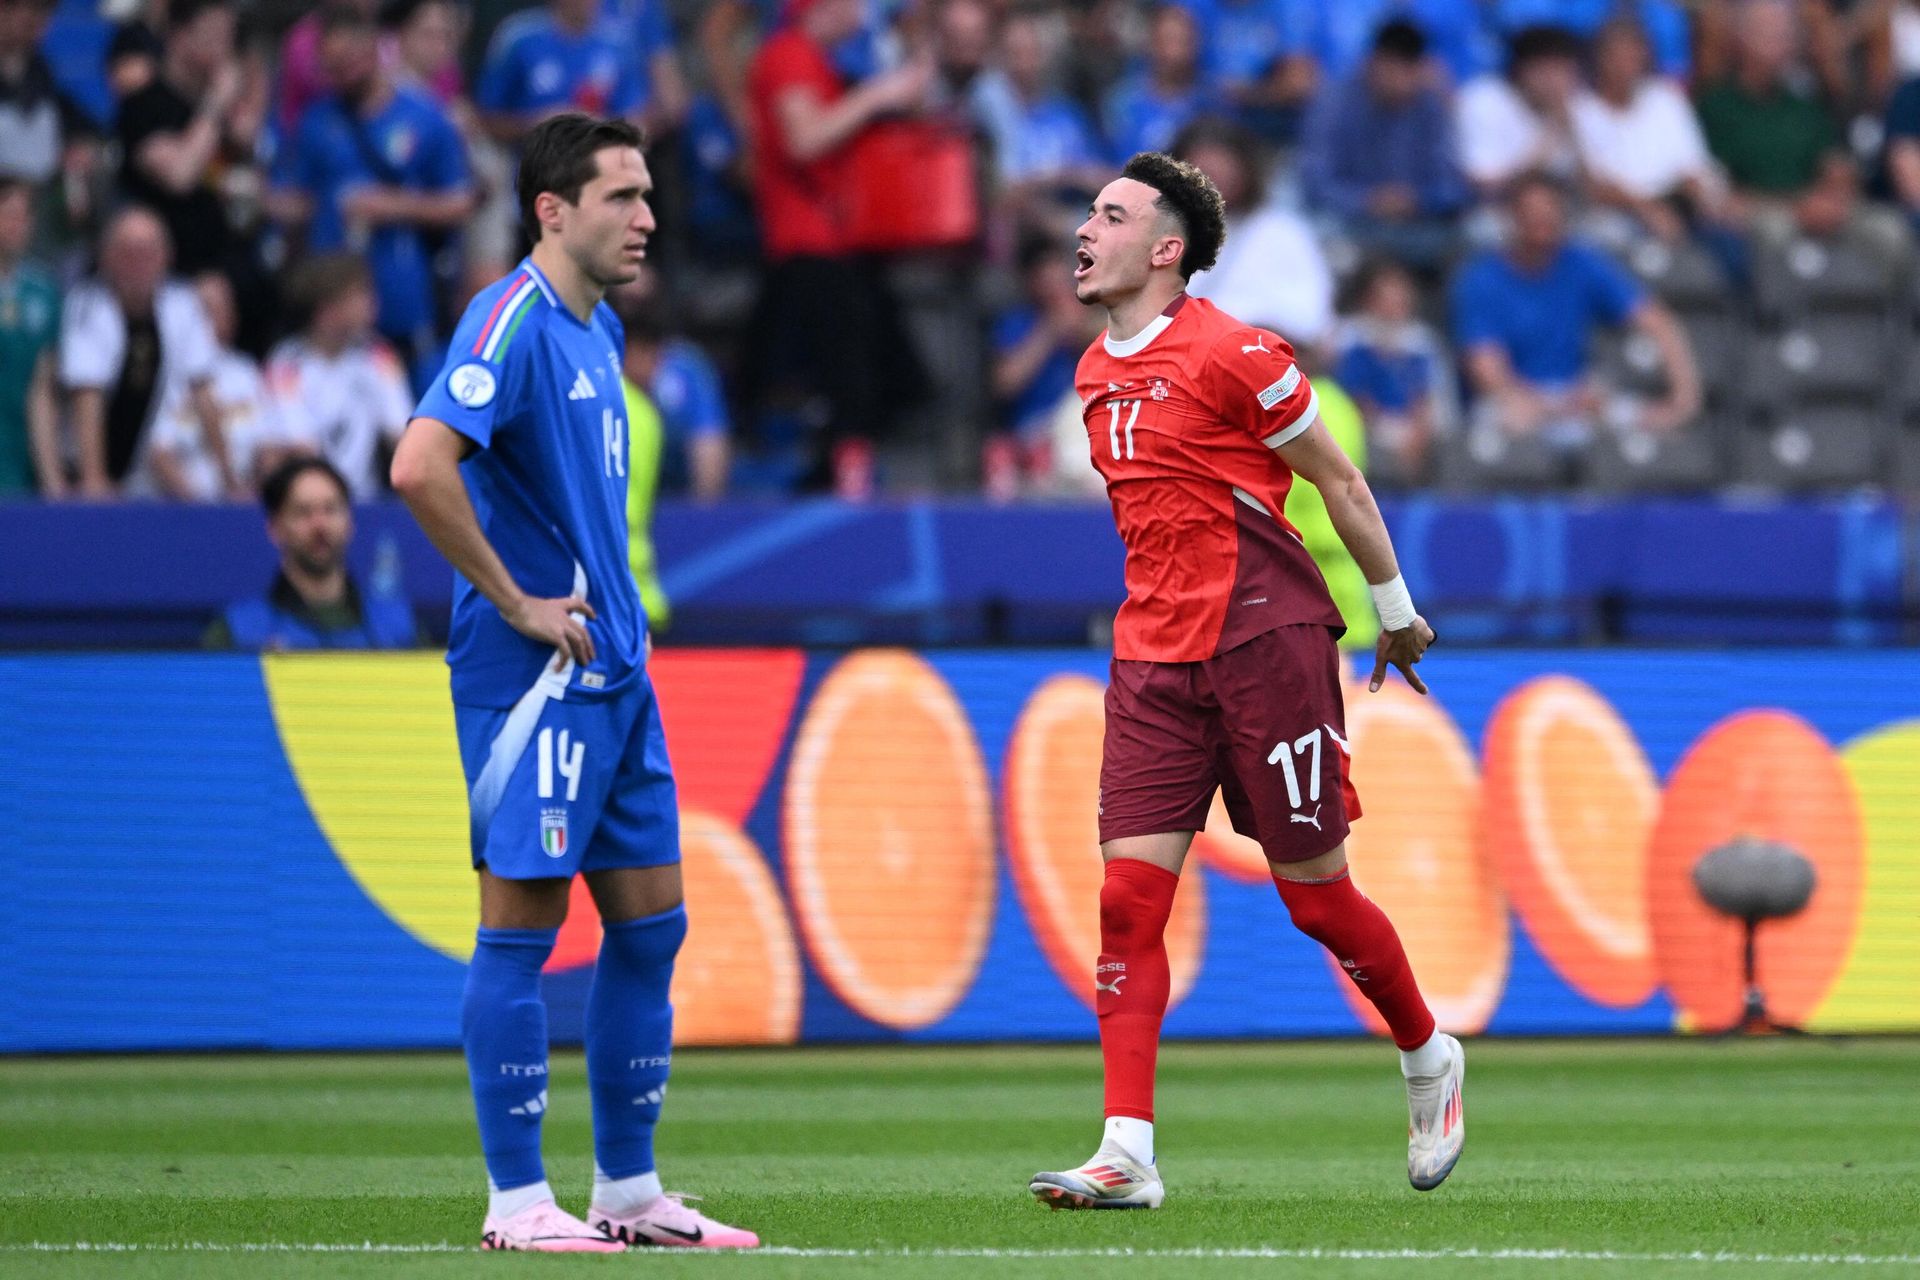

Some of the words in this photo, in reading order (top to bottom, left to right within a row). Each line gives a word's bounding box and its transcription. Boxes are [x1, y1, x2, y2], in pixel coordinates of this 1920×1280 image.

[602, 407, 625, 479] 14
[1106, 399, 1141, 461] 17
[537, 726, 586, 802] 14
[1267, 728, 1321, 808] 17
